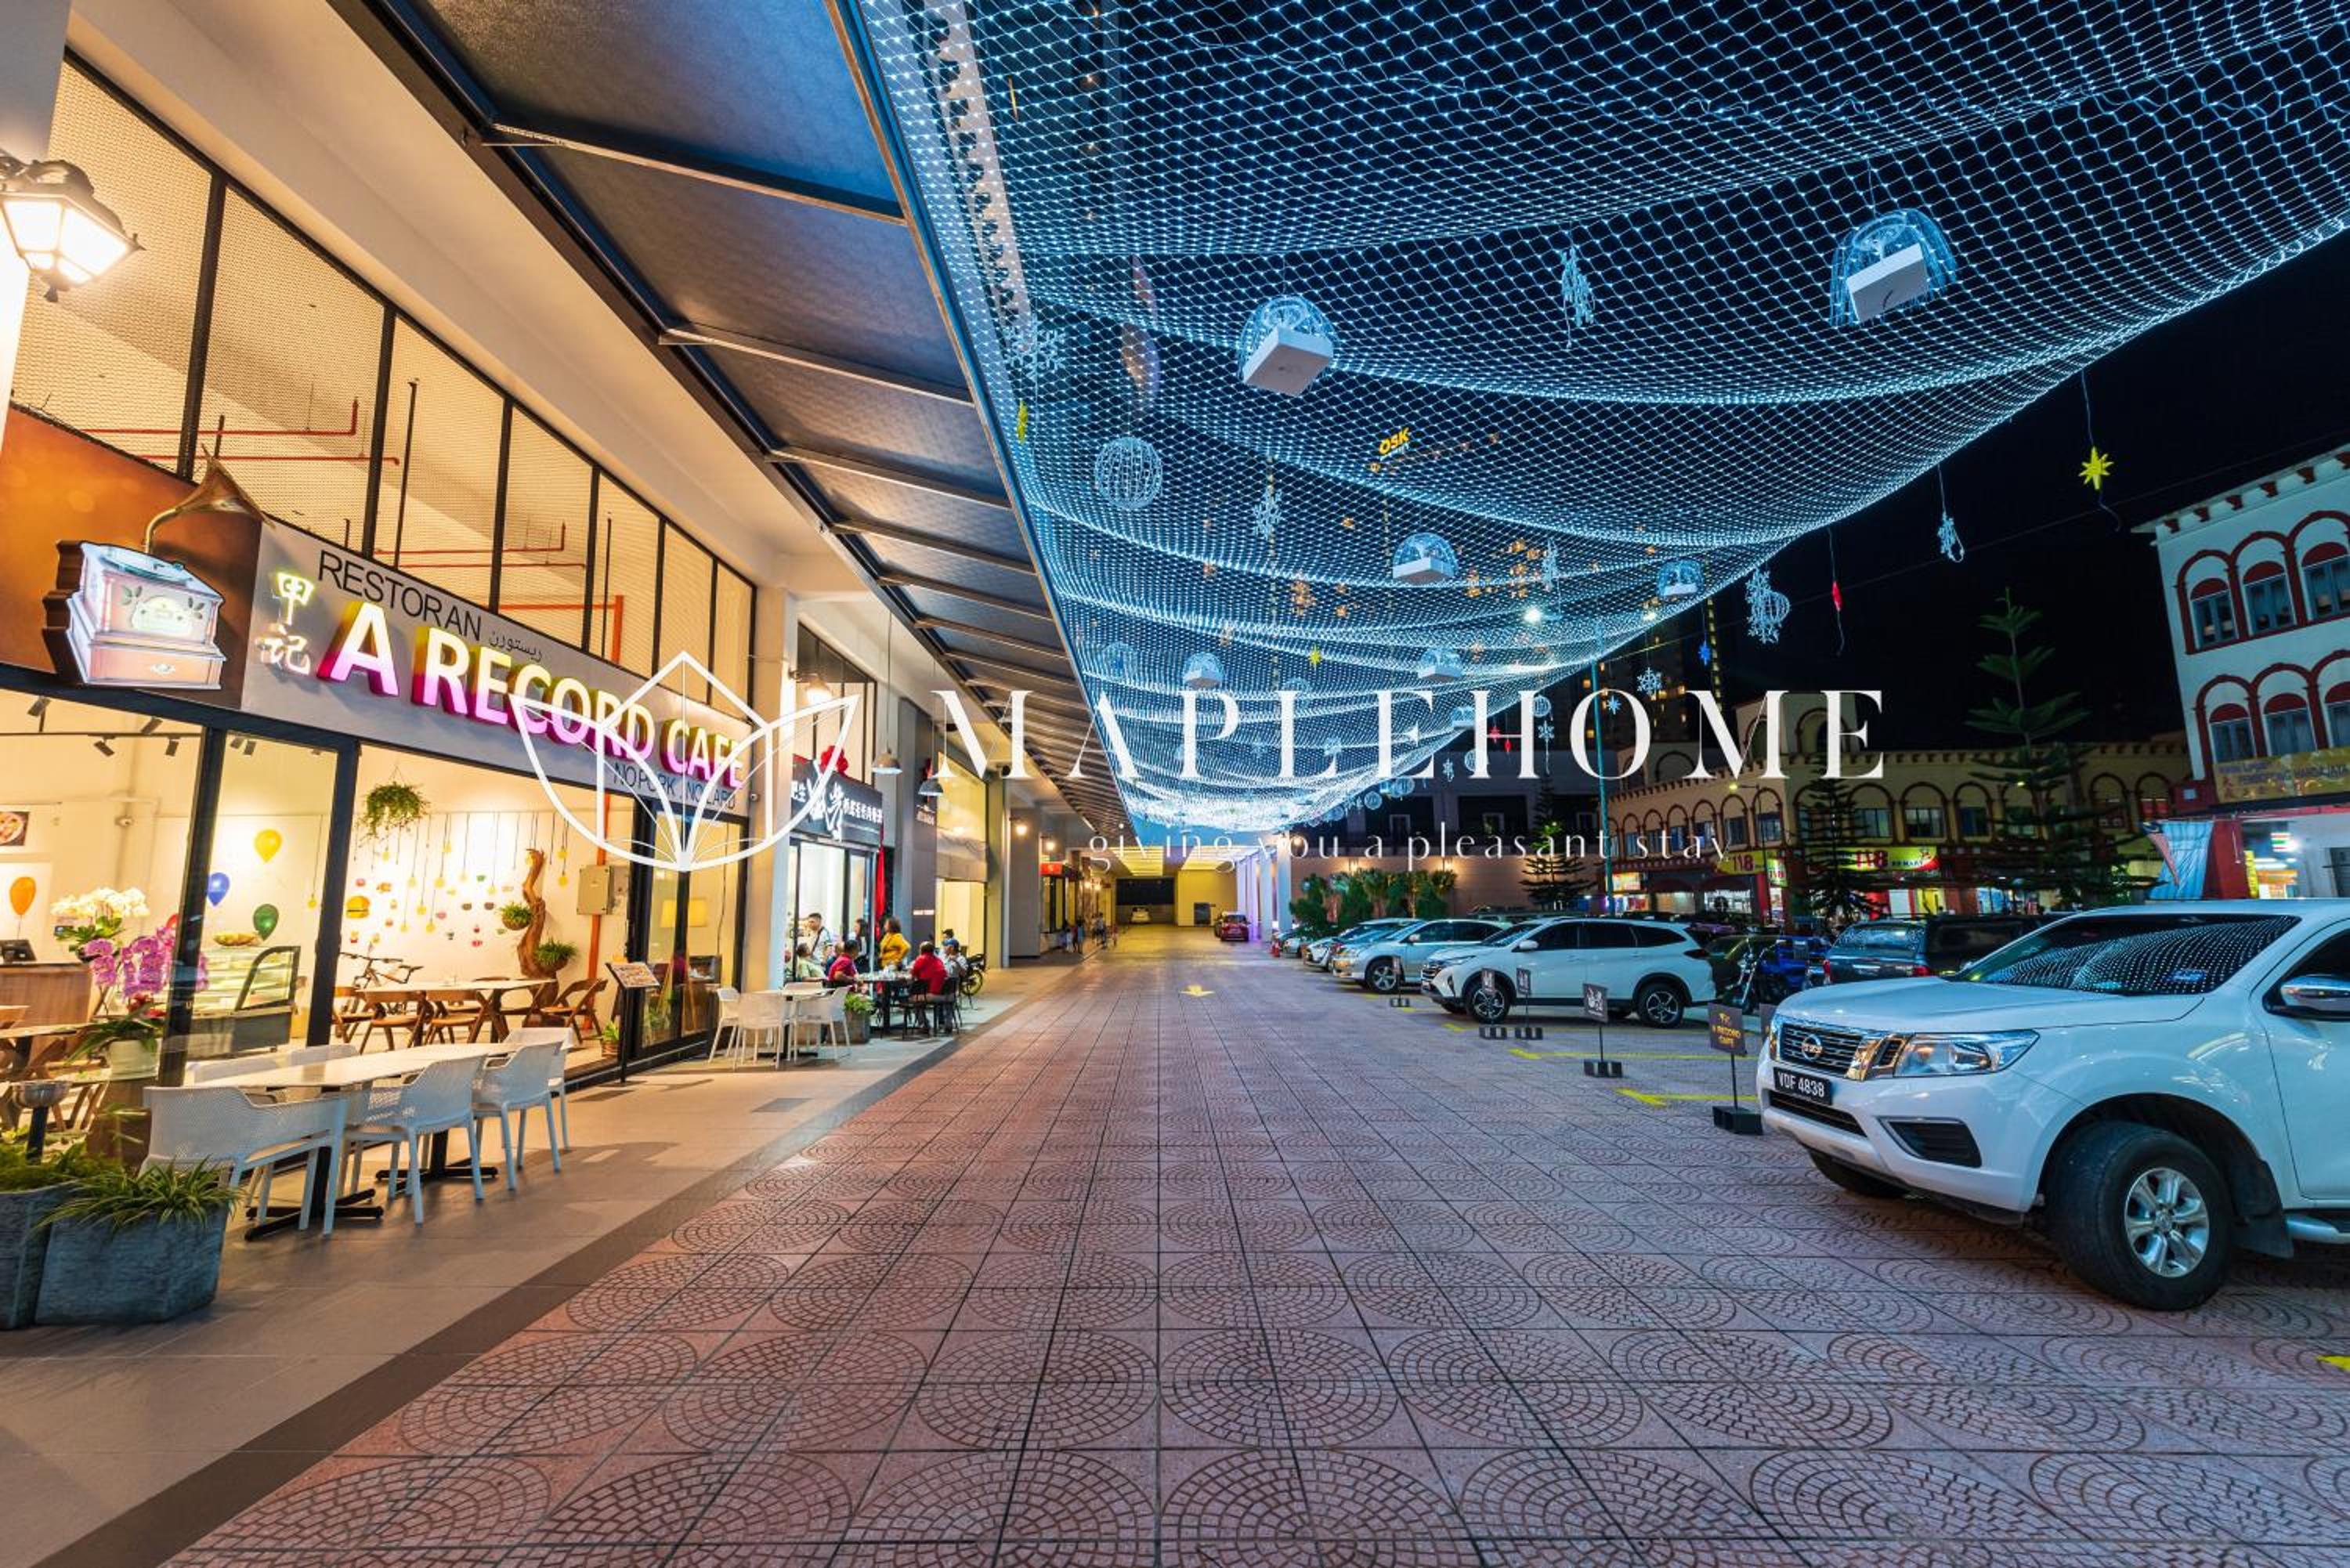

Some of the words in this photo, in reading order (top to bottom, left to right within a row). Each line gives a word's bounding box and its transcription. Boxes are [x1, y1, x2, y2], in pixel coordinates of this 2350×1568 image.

[318, 550, 483, 641] RESTORAN
[316, 602, 400, 697] A
[412, 627, 655, 763] RECORD
[661, 718, 745, 789] CAFE
[1732, 854, 1755, 873] 118
[1856, 851, 1889, 869] 118
[1797, 1077, 1825, 1098] 4838
